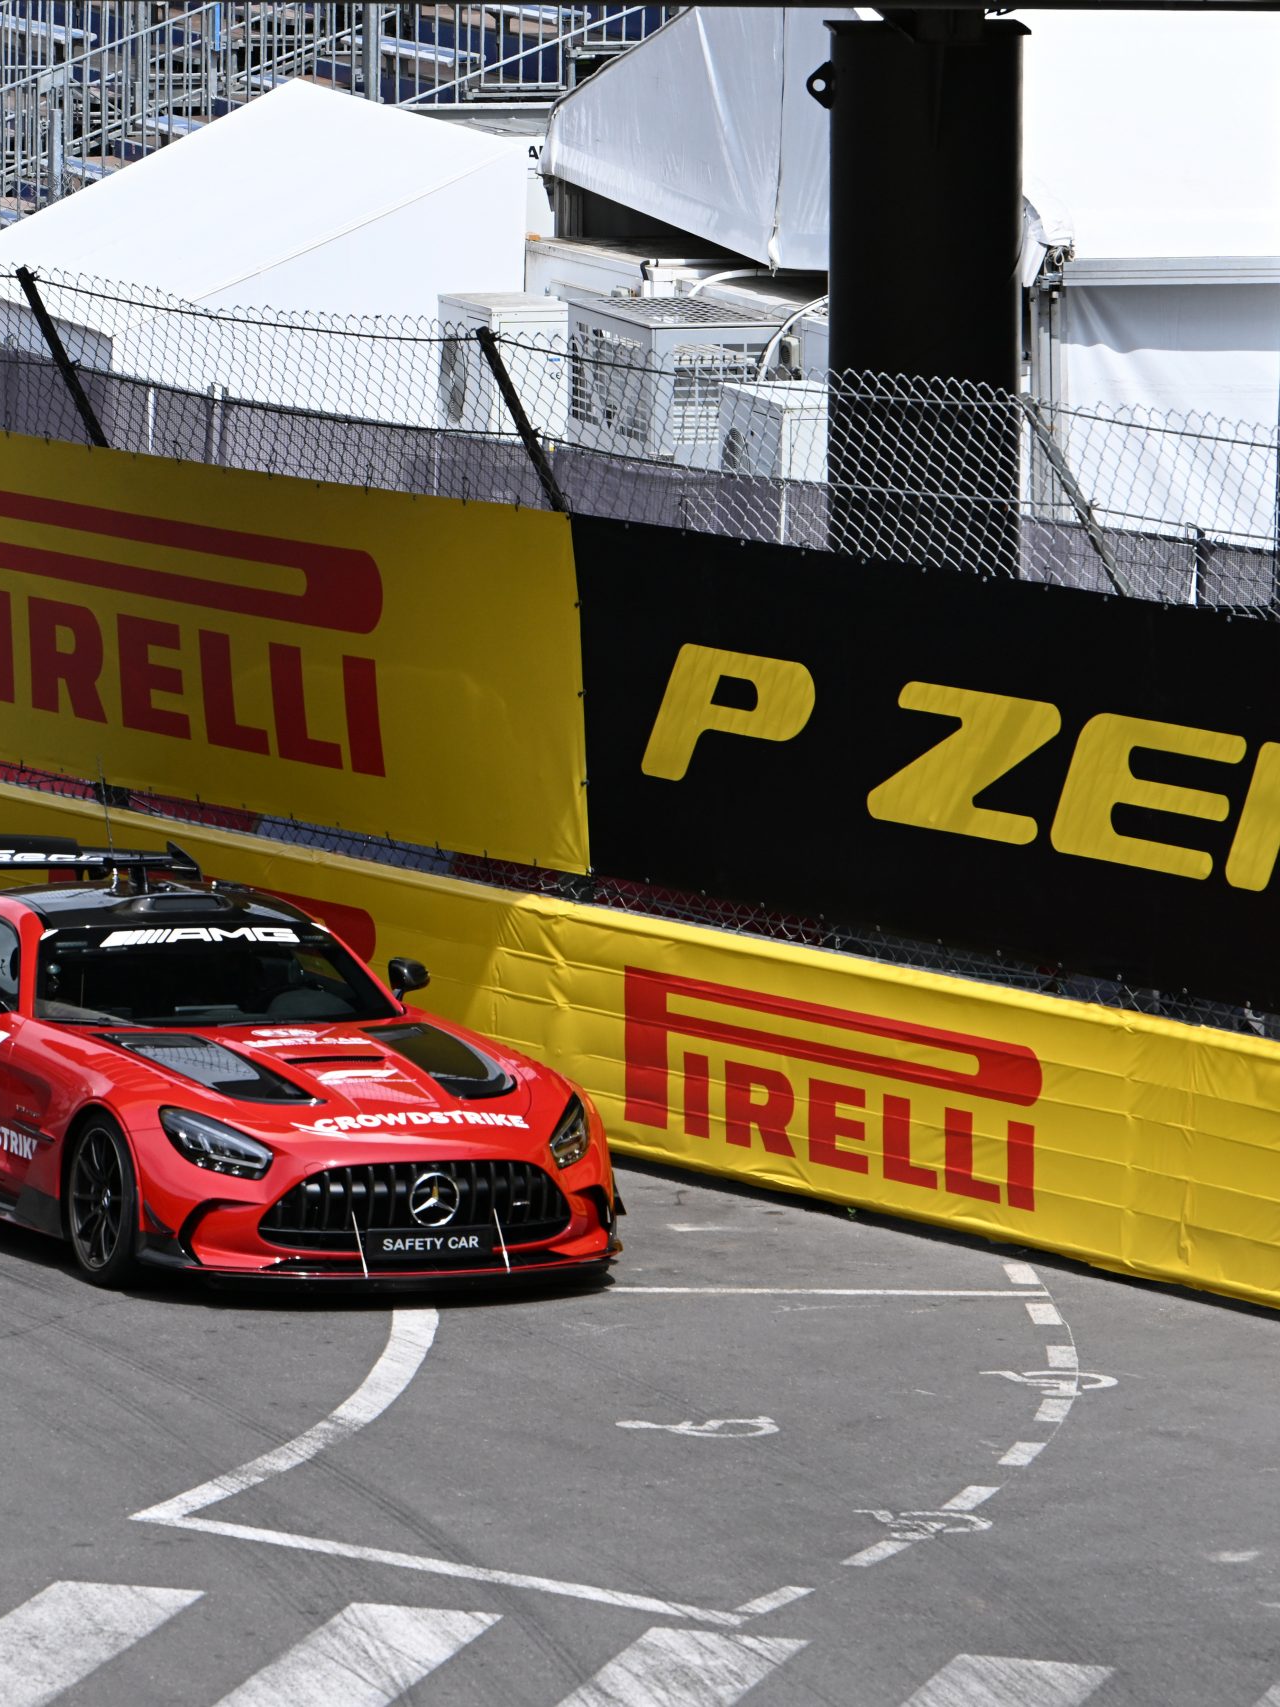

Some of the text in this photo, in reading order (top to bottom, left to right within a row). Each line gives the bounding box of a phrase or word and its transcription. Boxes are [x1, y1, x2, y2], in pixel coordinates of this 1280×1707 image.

[640, 642, 816, 782] P
[165, 927, 300, 944] AMG
[624, 965, 1043, 1212] PIRELLI
[313, 1110, 530, 1133] CROWDSTRIKE
[382, 1236, 479, 1251] SAFETY CAR
